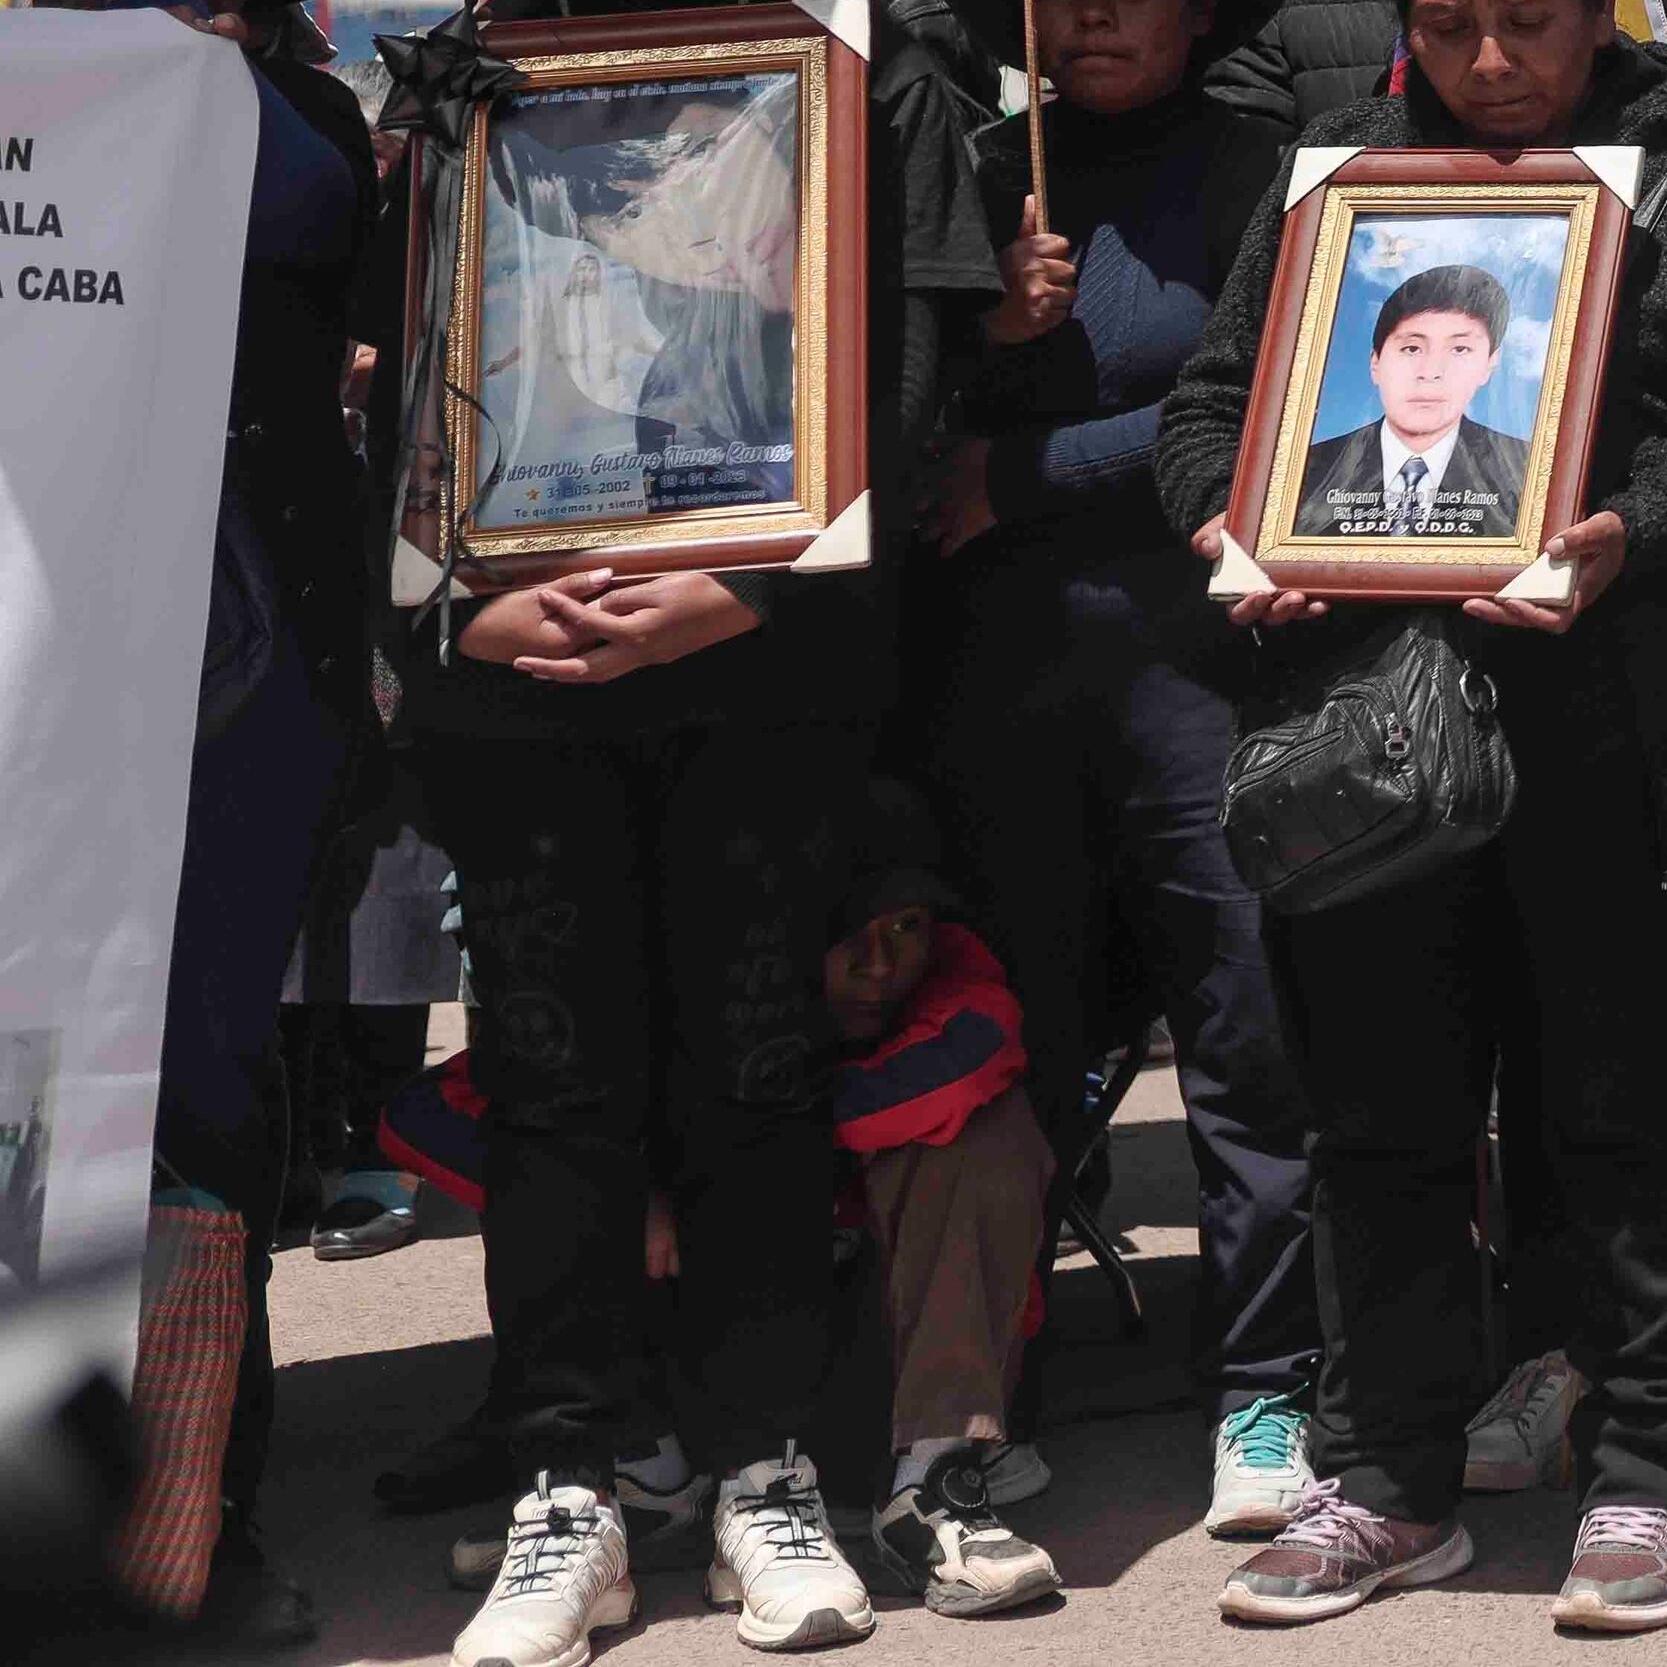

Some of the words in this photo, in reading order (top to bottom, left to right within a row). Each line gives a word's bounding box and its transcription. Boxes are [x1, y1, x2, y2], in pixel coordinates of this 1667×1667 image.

[0, 137, 34, 162] N
[17, 265, 125, 306] CABA
[724, 440, 794, 466] Ramos
[1326, 487, 1383, 507] Ghiovanny
[1462, 488, 1500, 506] Ramos
[514, 509, 528, 518] Te
[532, 504, 593, 519] queremos
[597, 502, 604, 513] y
[1339, 520, 1394, 535] Q.E.P.D.
[1399, 523, 1410, 535] y
[1414, 520, 1475, 535] Q.D.D.G.
